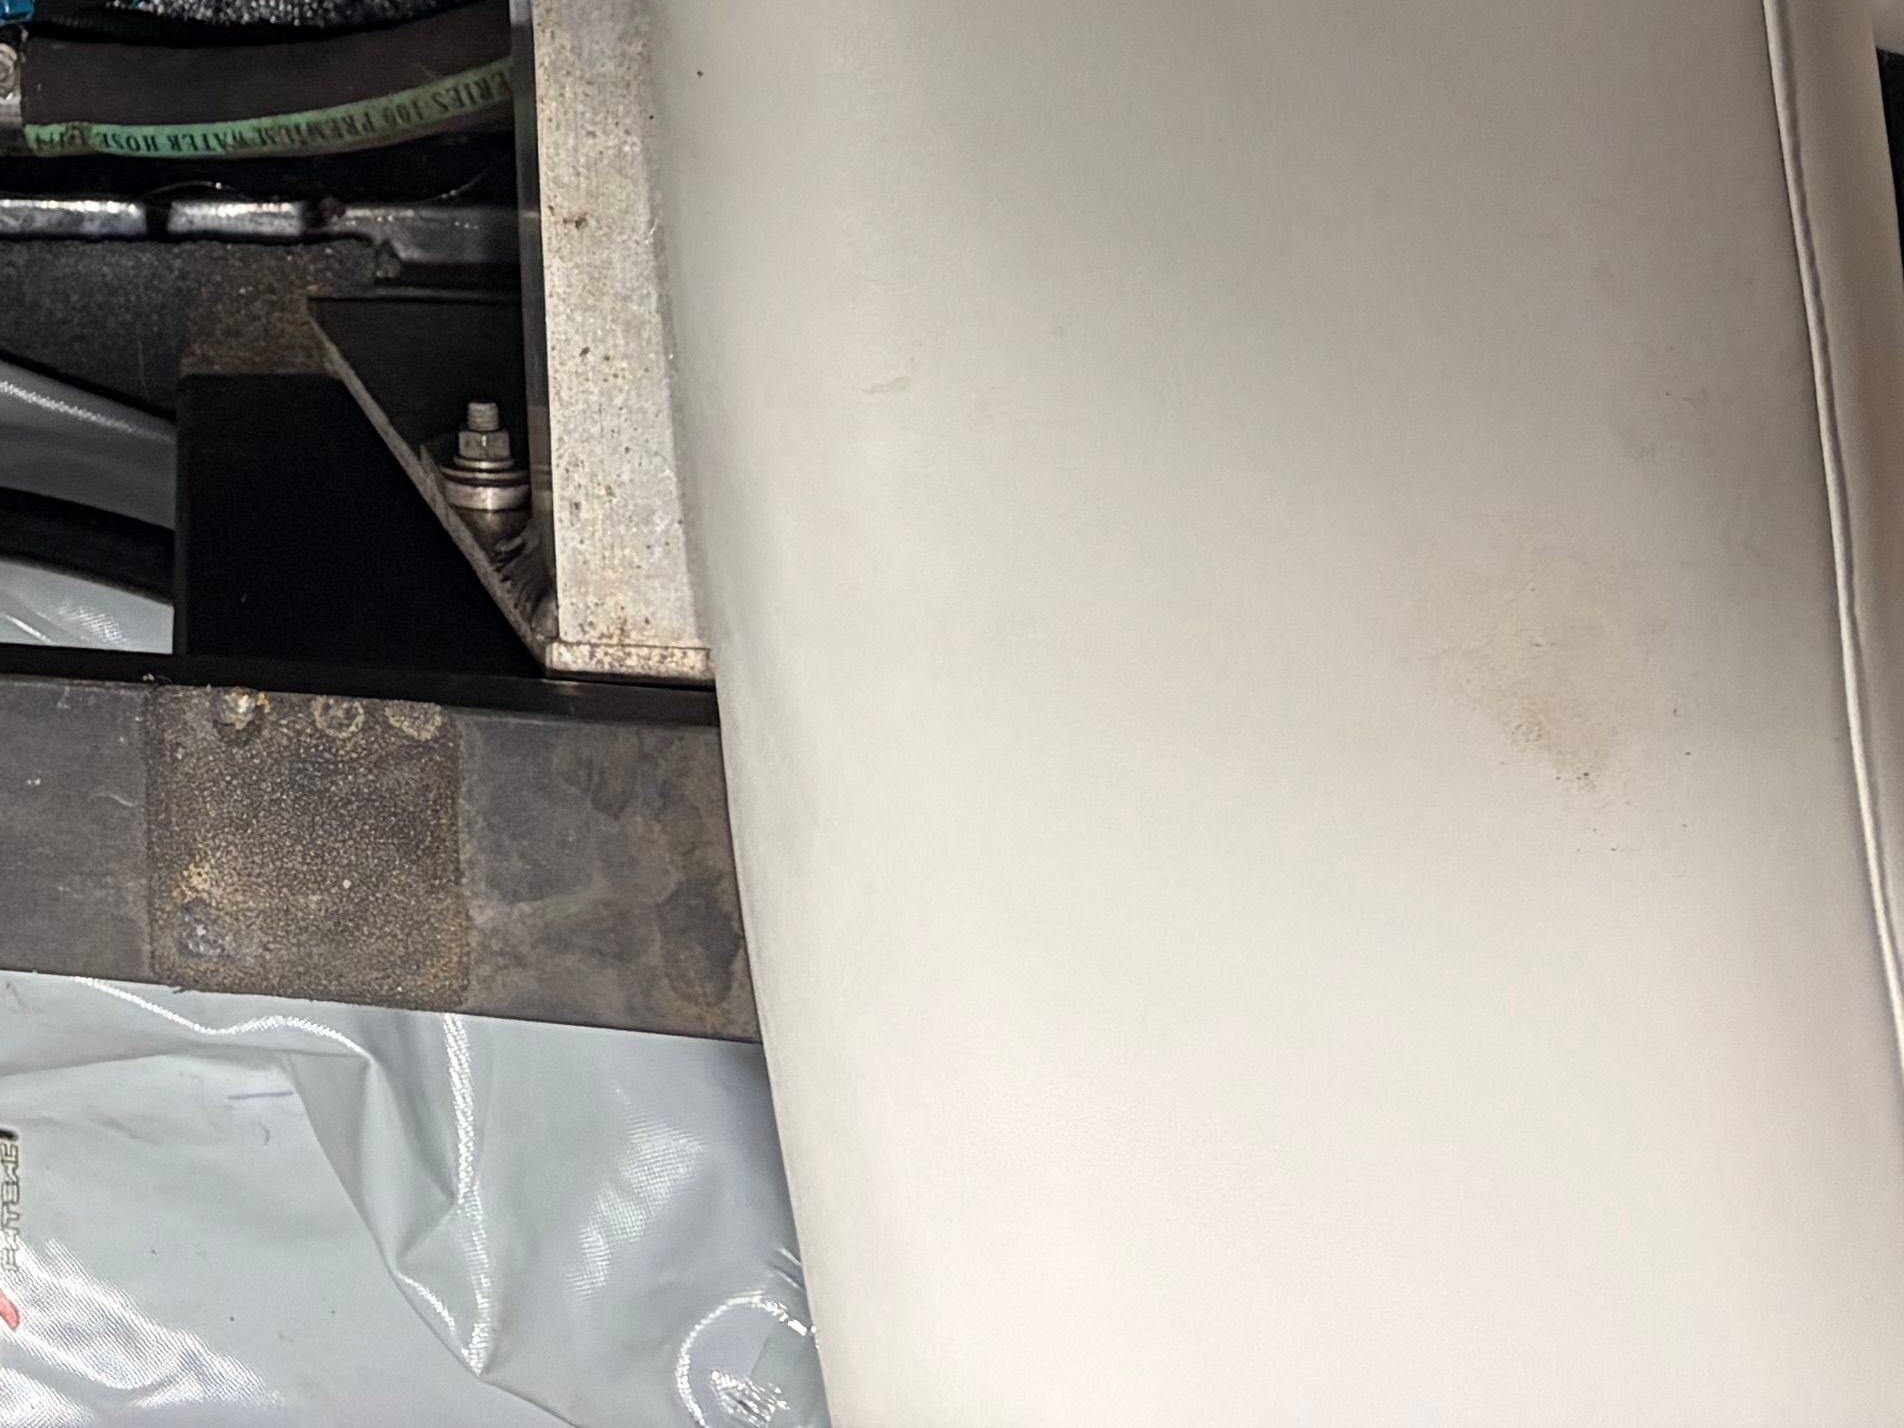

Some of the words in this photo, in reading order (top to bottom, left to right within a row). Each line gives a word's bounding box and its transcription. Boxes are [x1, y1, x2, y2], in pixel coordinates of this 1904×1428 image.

[433, 70, 510, 113] ERIES
[95, 130, 156, 153] HOSE
[169, 127, 248, 153] WATER
